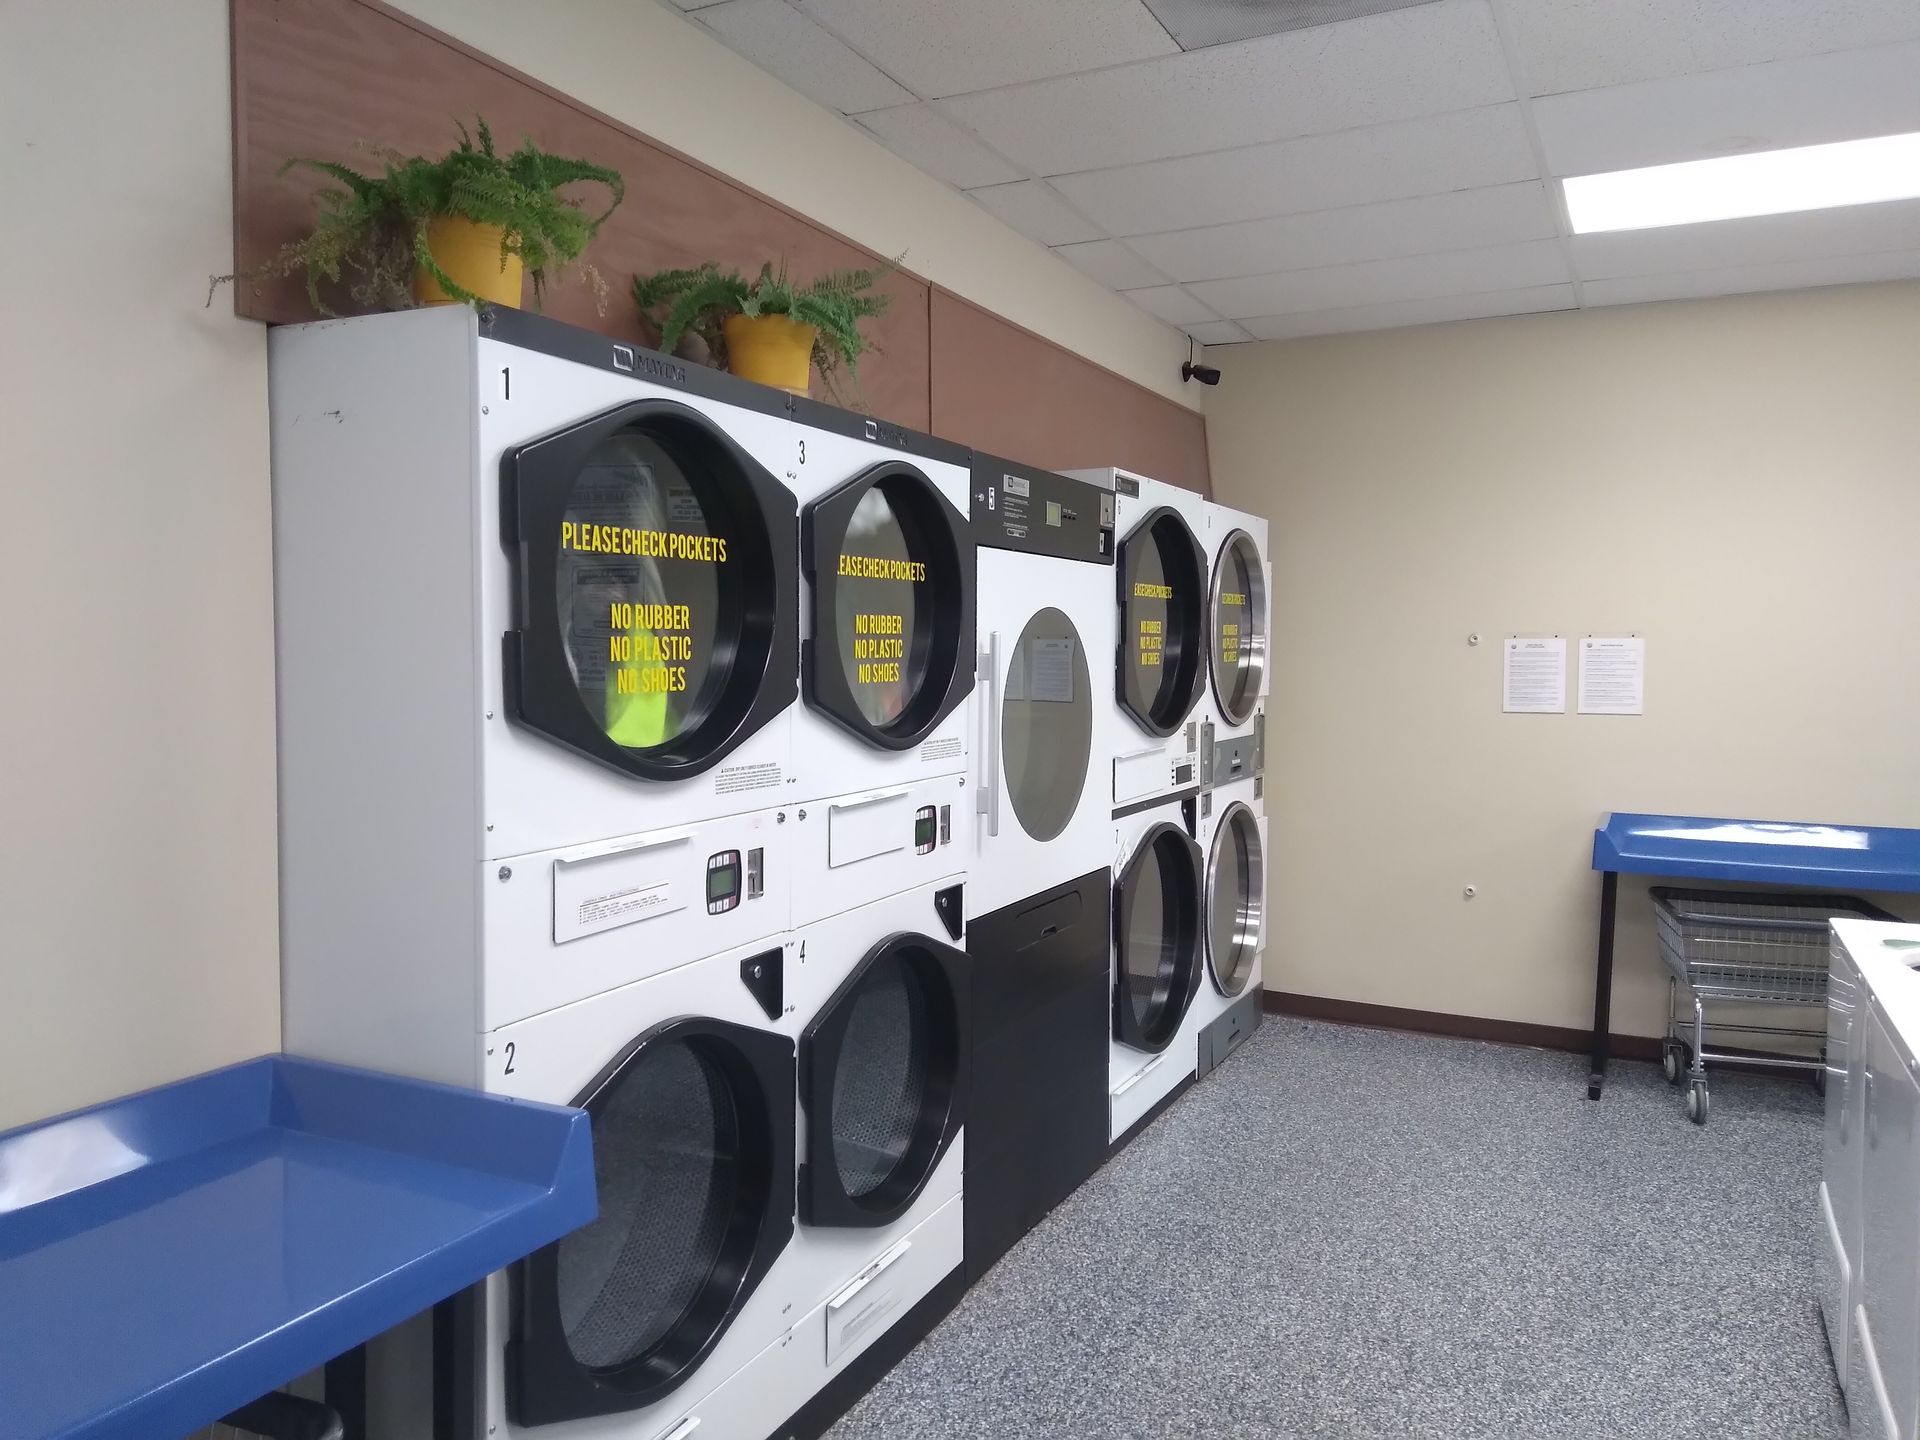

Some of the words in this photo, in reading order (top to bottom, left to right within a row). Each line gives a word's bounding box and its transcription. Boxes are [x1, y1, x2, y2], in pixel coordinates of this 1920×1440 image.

[501, 367, 510, 400] 1
[799, 440, 805, 465] 3
[562, 521, 621, 554] PLEASE
[622, 528, 668, 557] CHECK
[670, 533, 727, 563] POCKETS
[837, 555, 863, 577] EASE
[863, 557, 890, 579] CHECK
[890, 560, 926, 582] POCKETS
[611, 603, 631, 629] NO
[635, 604, 690, 630] RUBBER
[855, 614, 868, 634] NO
[869, 614, 902, 634] RUBBER
[610, 636, 630, 662] NO
[634, 636, 692, 662] PLASTIC
[855, 639, 867, 659] NO
[869, 639, 903, 659] PLASTIC
[617, 668, 638, 694] NO
[641, 666, 686, 692] SHOES
[859, 663, 871, 684] NO
[872, 662, 900, 683] SHOES
[799, 940, 806, 964] 4
[504, 1042, 515, 1075] 2
